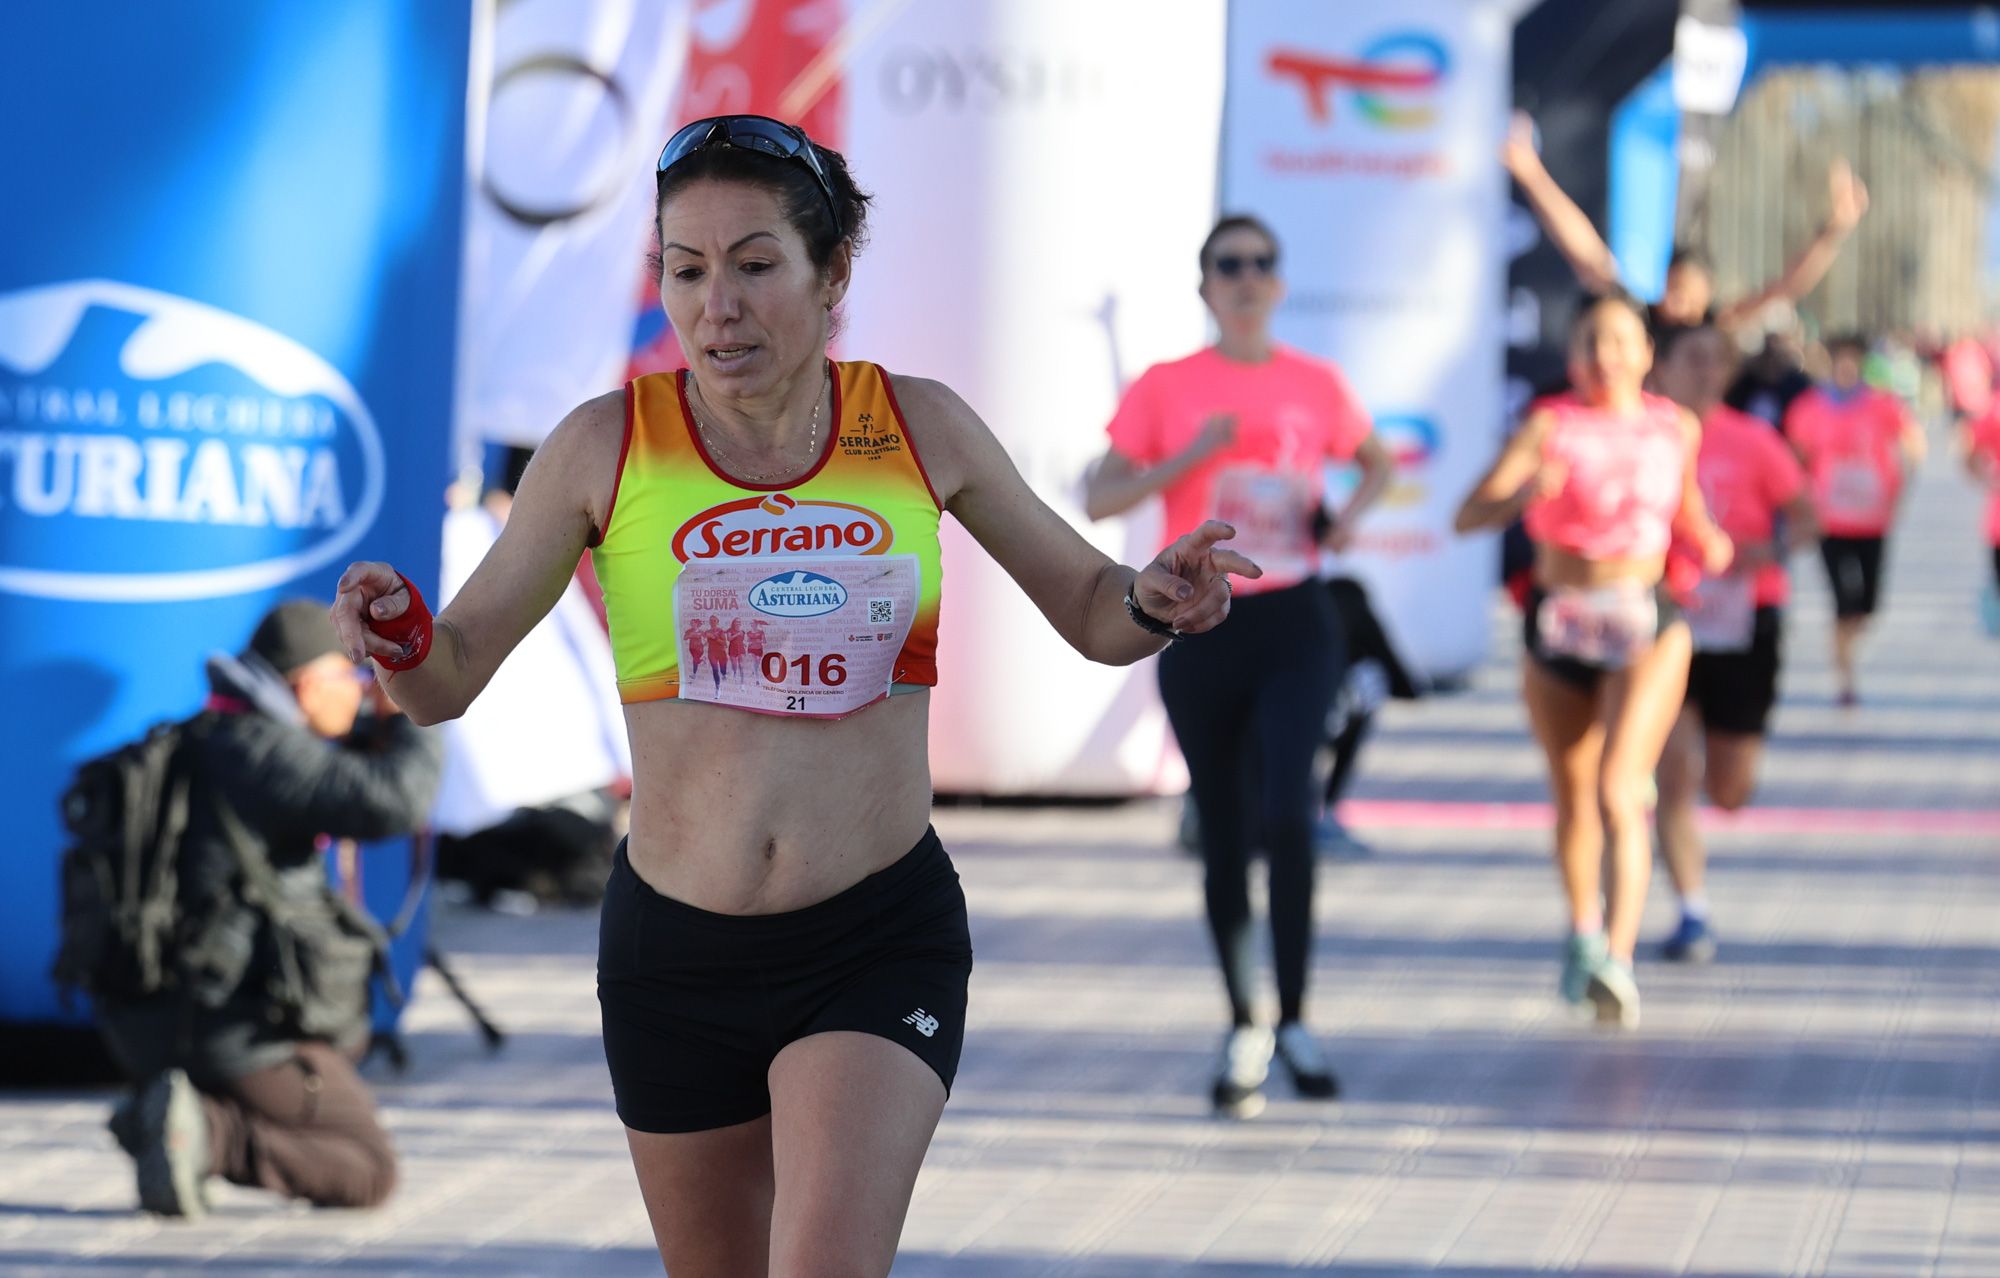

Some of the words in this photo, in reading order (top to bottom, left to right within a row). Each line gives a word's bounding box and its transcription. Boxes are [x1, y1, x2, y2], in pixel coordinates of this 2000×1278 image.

[839, 434, 900, 448] SERRANO
[863, 446, 901, 455] ATLETISMO
[692, 521, 874, 559] Serrano
[704, 589, 738, 597] DORSAL
[756, 588, 841, 606] ASTURIANA
[693, 598, 739, 610] SUMA
[761, 651, 847, 687] 016
[786, 696, 805, 710] 21
